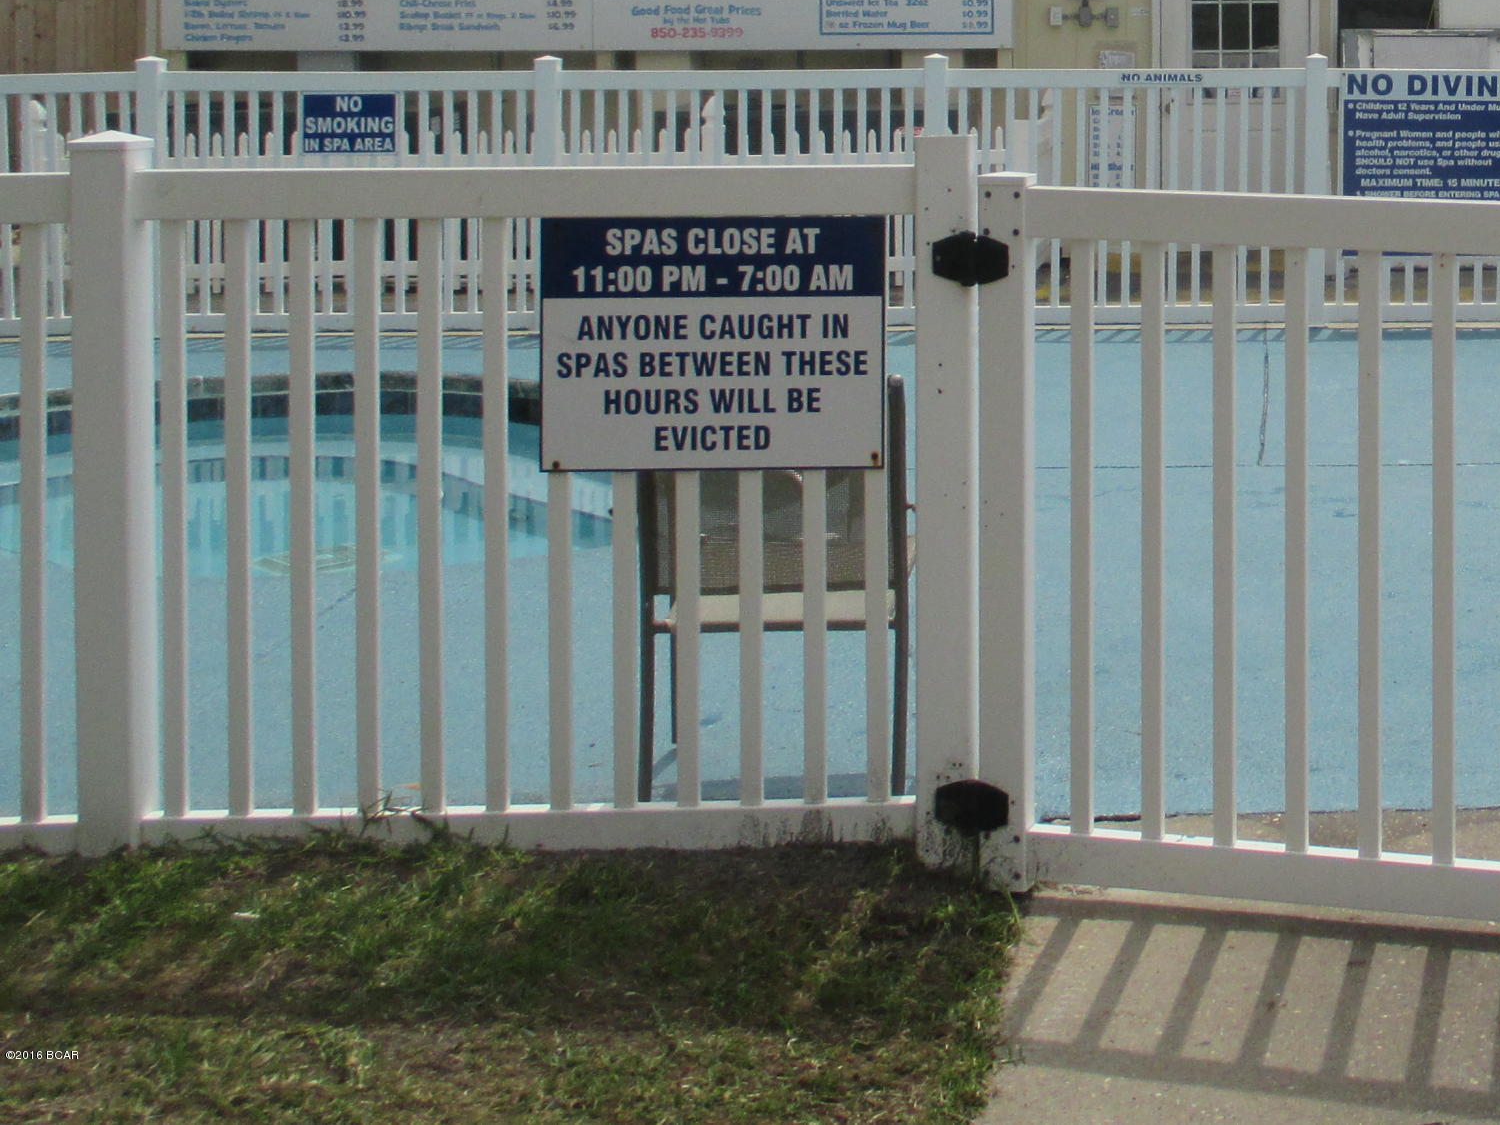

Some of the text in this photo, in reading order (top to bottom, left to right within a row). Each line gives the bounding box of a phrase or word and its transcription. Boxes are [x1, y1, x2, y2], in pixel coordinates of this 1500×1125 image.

[631, 6, 661, 16] Good
[663, 5, 691, 15] Food
[728, 5, 762, 16] Prices
[1121, 73, 1203, 83] NO ANIMALS
[1346, 73, 1394, 96] NO
[335, 96, 363, 112] NO
[1355, 102, 1394, 110] Children
[1410, 103, 1435, 111] Years
[1437, 103, 1456, 111] And
[1458, 103, 1486, 111] Under
[1355, 112, 1462, 121] Have Adult Supervision
[304, 116, 394, 134] SMOKING
[1355, 130, 1397, 140] Pregnant
[1399, 130, 1433, 139] Women
[1435, 130, 1453, 139] and
[1455, 131, 1486, 140] people
[304, 137, 394, 152] IN SPA AREA
[1355, 139, 1386, 148] health
[1435, 140, 1453, 148] and
[1455, 140, 1486, 149] people
[1454, 149, 1478, 158] other
[1355, 158, 1394, 166] SHOULD
[1396, 158, 1416, 166] NOT
[1437, 158, 1455, 167] Spa
[1457, 158, 1493, 166] without
[1355, 167, 1391, 175] doctors
[1360, 178, 1413, 187] MAXIMUM
[1415, 178, 1444, 187] TIME:
[1447, 179, 1458, 187] 15
[1403, 190, 1436, 198] BEFORE
[1438, 190, 1482, 198] ENTERING
[605, 227, 821, 256] SPAS CLOSE AT
[572, 265, 652, 293] 11:00
[661, 265, 706, 291] PM
[737, 264, 800, 292] 7:00
[808, 263, 854, 291] AM
[577, 313, 850, 341] ANYONE CAUGHT IN
[556, 350, 868, 379] SPAS BETWEEN THESE
[603, 387, 821, 415] HOURS WILL BE
[654, 425, 771, 451] EVICTED
